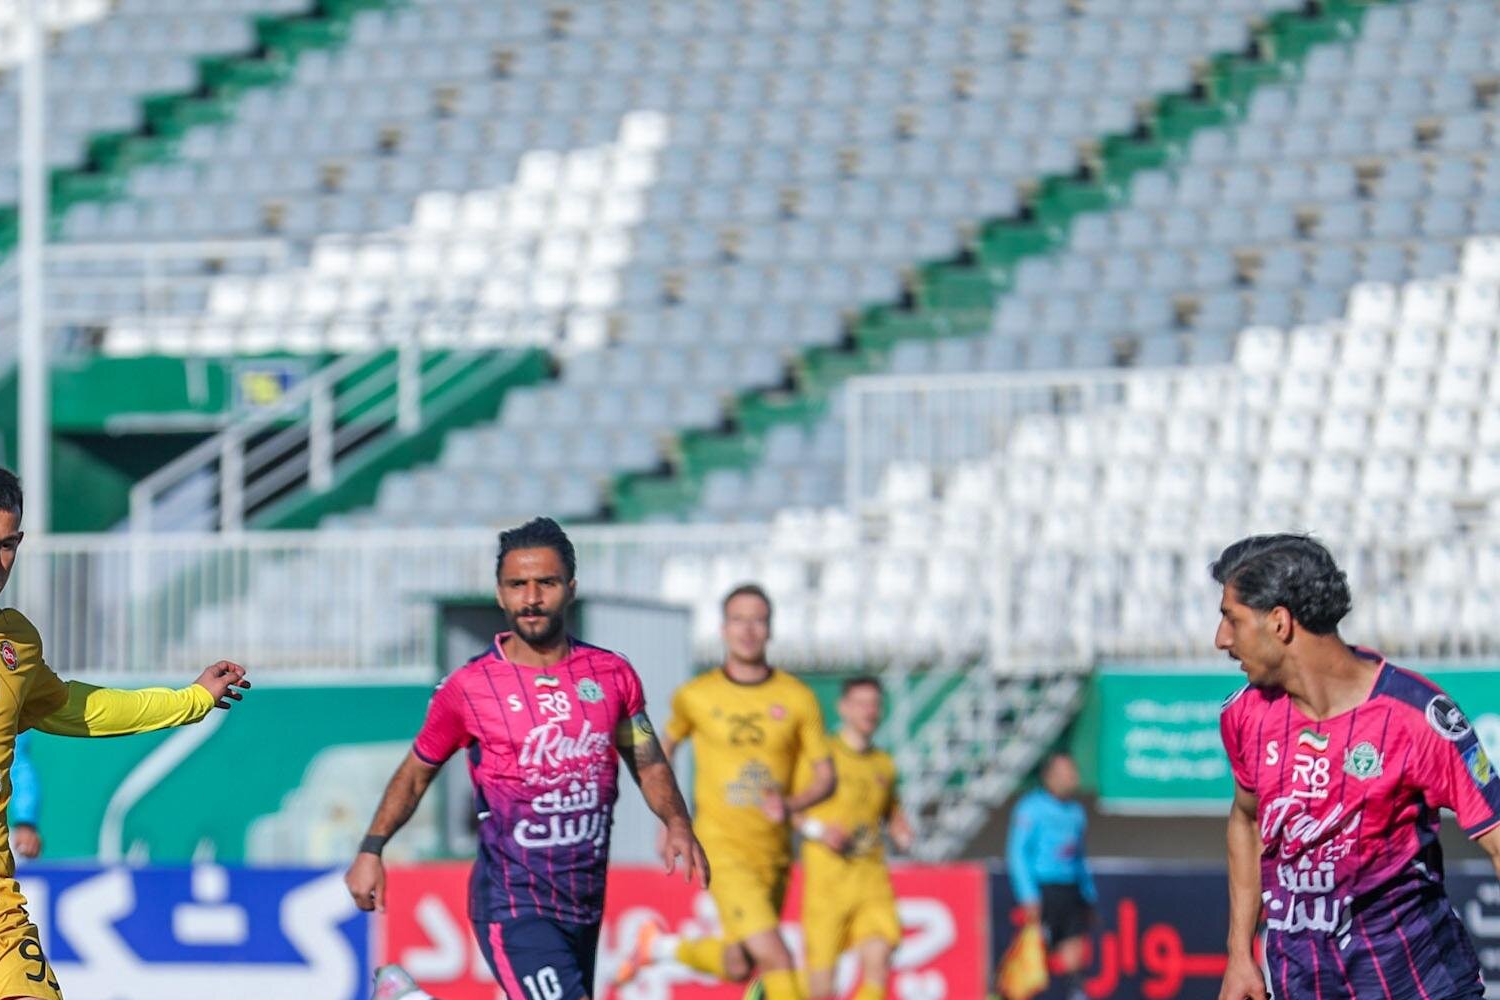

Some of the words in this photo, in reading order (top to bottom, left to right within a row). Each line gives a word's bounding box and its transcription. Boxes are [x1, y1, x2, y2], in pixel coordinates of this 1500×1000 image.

[535, 690, 571, 715] R8
[728, 713, 765, 746] 25
[1291, 753, 1331, 787] R8
[18, 938, 61, 991] 9
